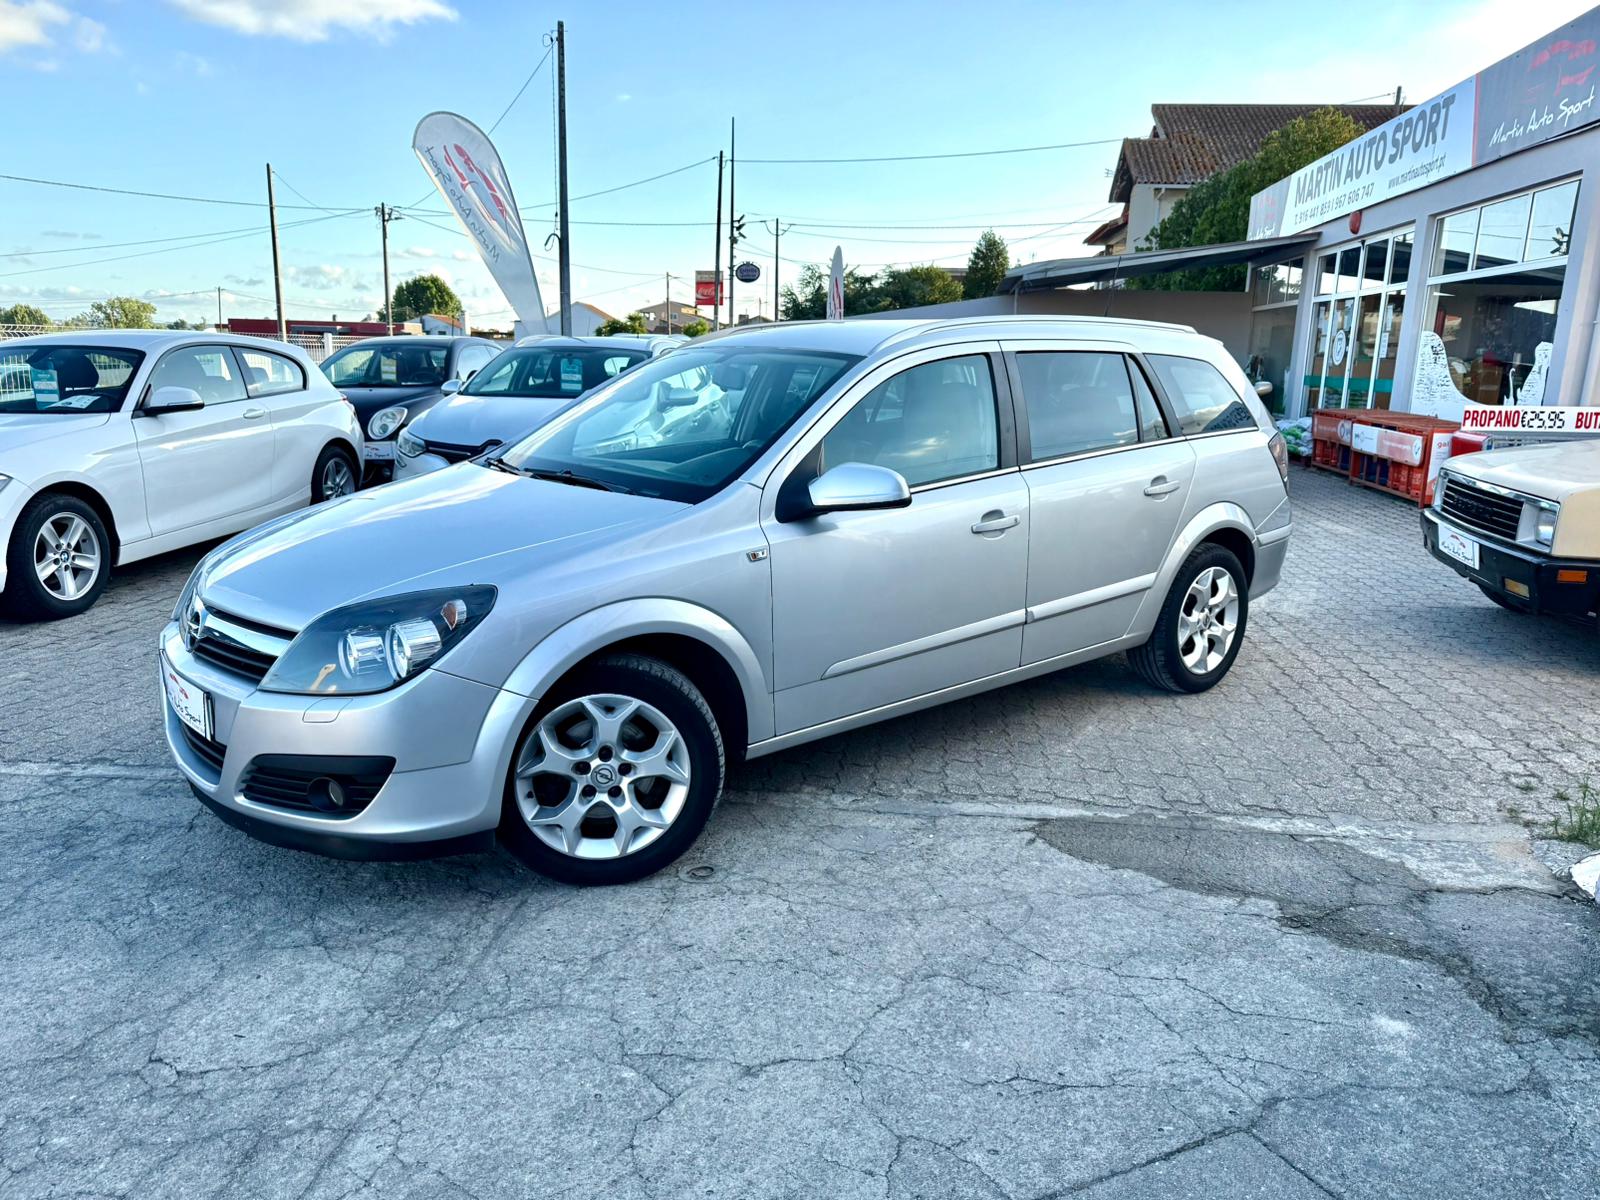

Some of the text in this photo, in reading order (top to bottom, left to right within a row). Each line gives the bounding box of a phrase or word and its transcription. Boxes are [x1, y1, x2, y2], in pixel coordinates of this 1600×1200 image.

[1488, 84, 1596, 148] Martin Auto Sport
[1294, 93, 1457, 208] MARTIN AUTO SPORT
[1462, 409, 1600, 430] PROPANO €25,95 BUT
